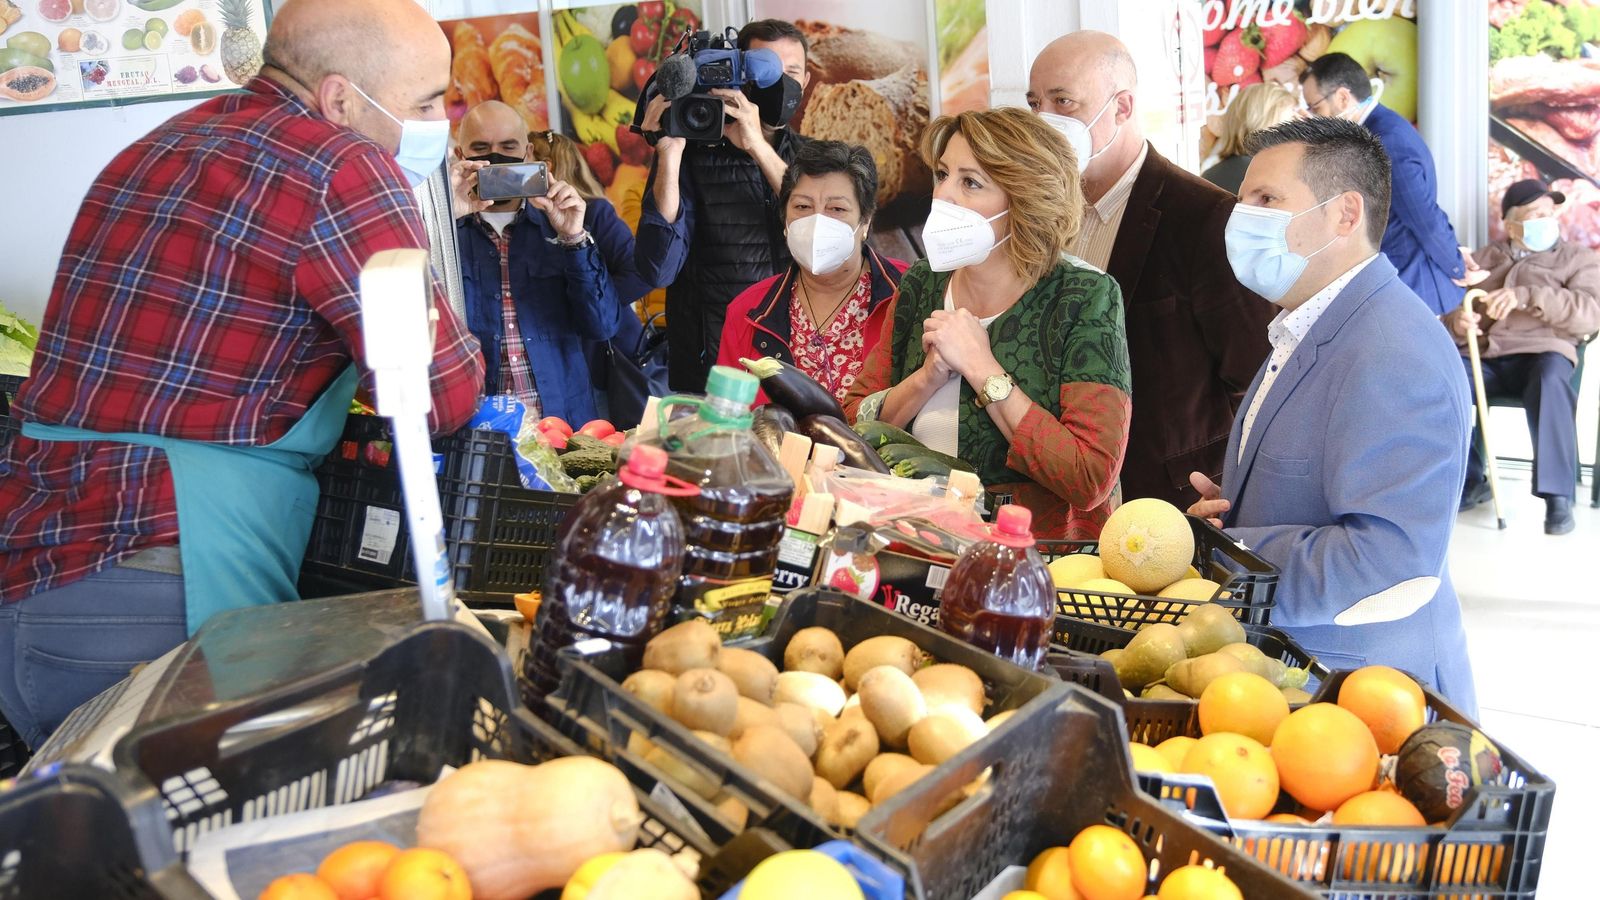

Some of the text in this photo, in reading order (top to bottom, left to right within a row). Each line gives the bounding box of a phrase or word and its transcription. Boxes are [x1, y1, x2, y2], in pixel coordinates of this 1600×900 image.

[1202, 0, 1293, 30] ome
[773, 568, 810, 590] erry
[894, 594, 941, 627] Rega
